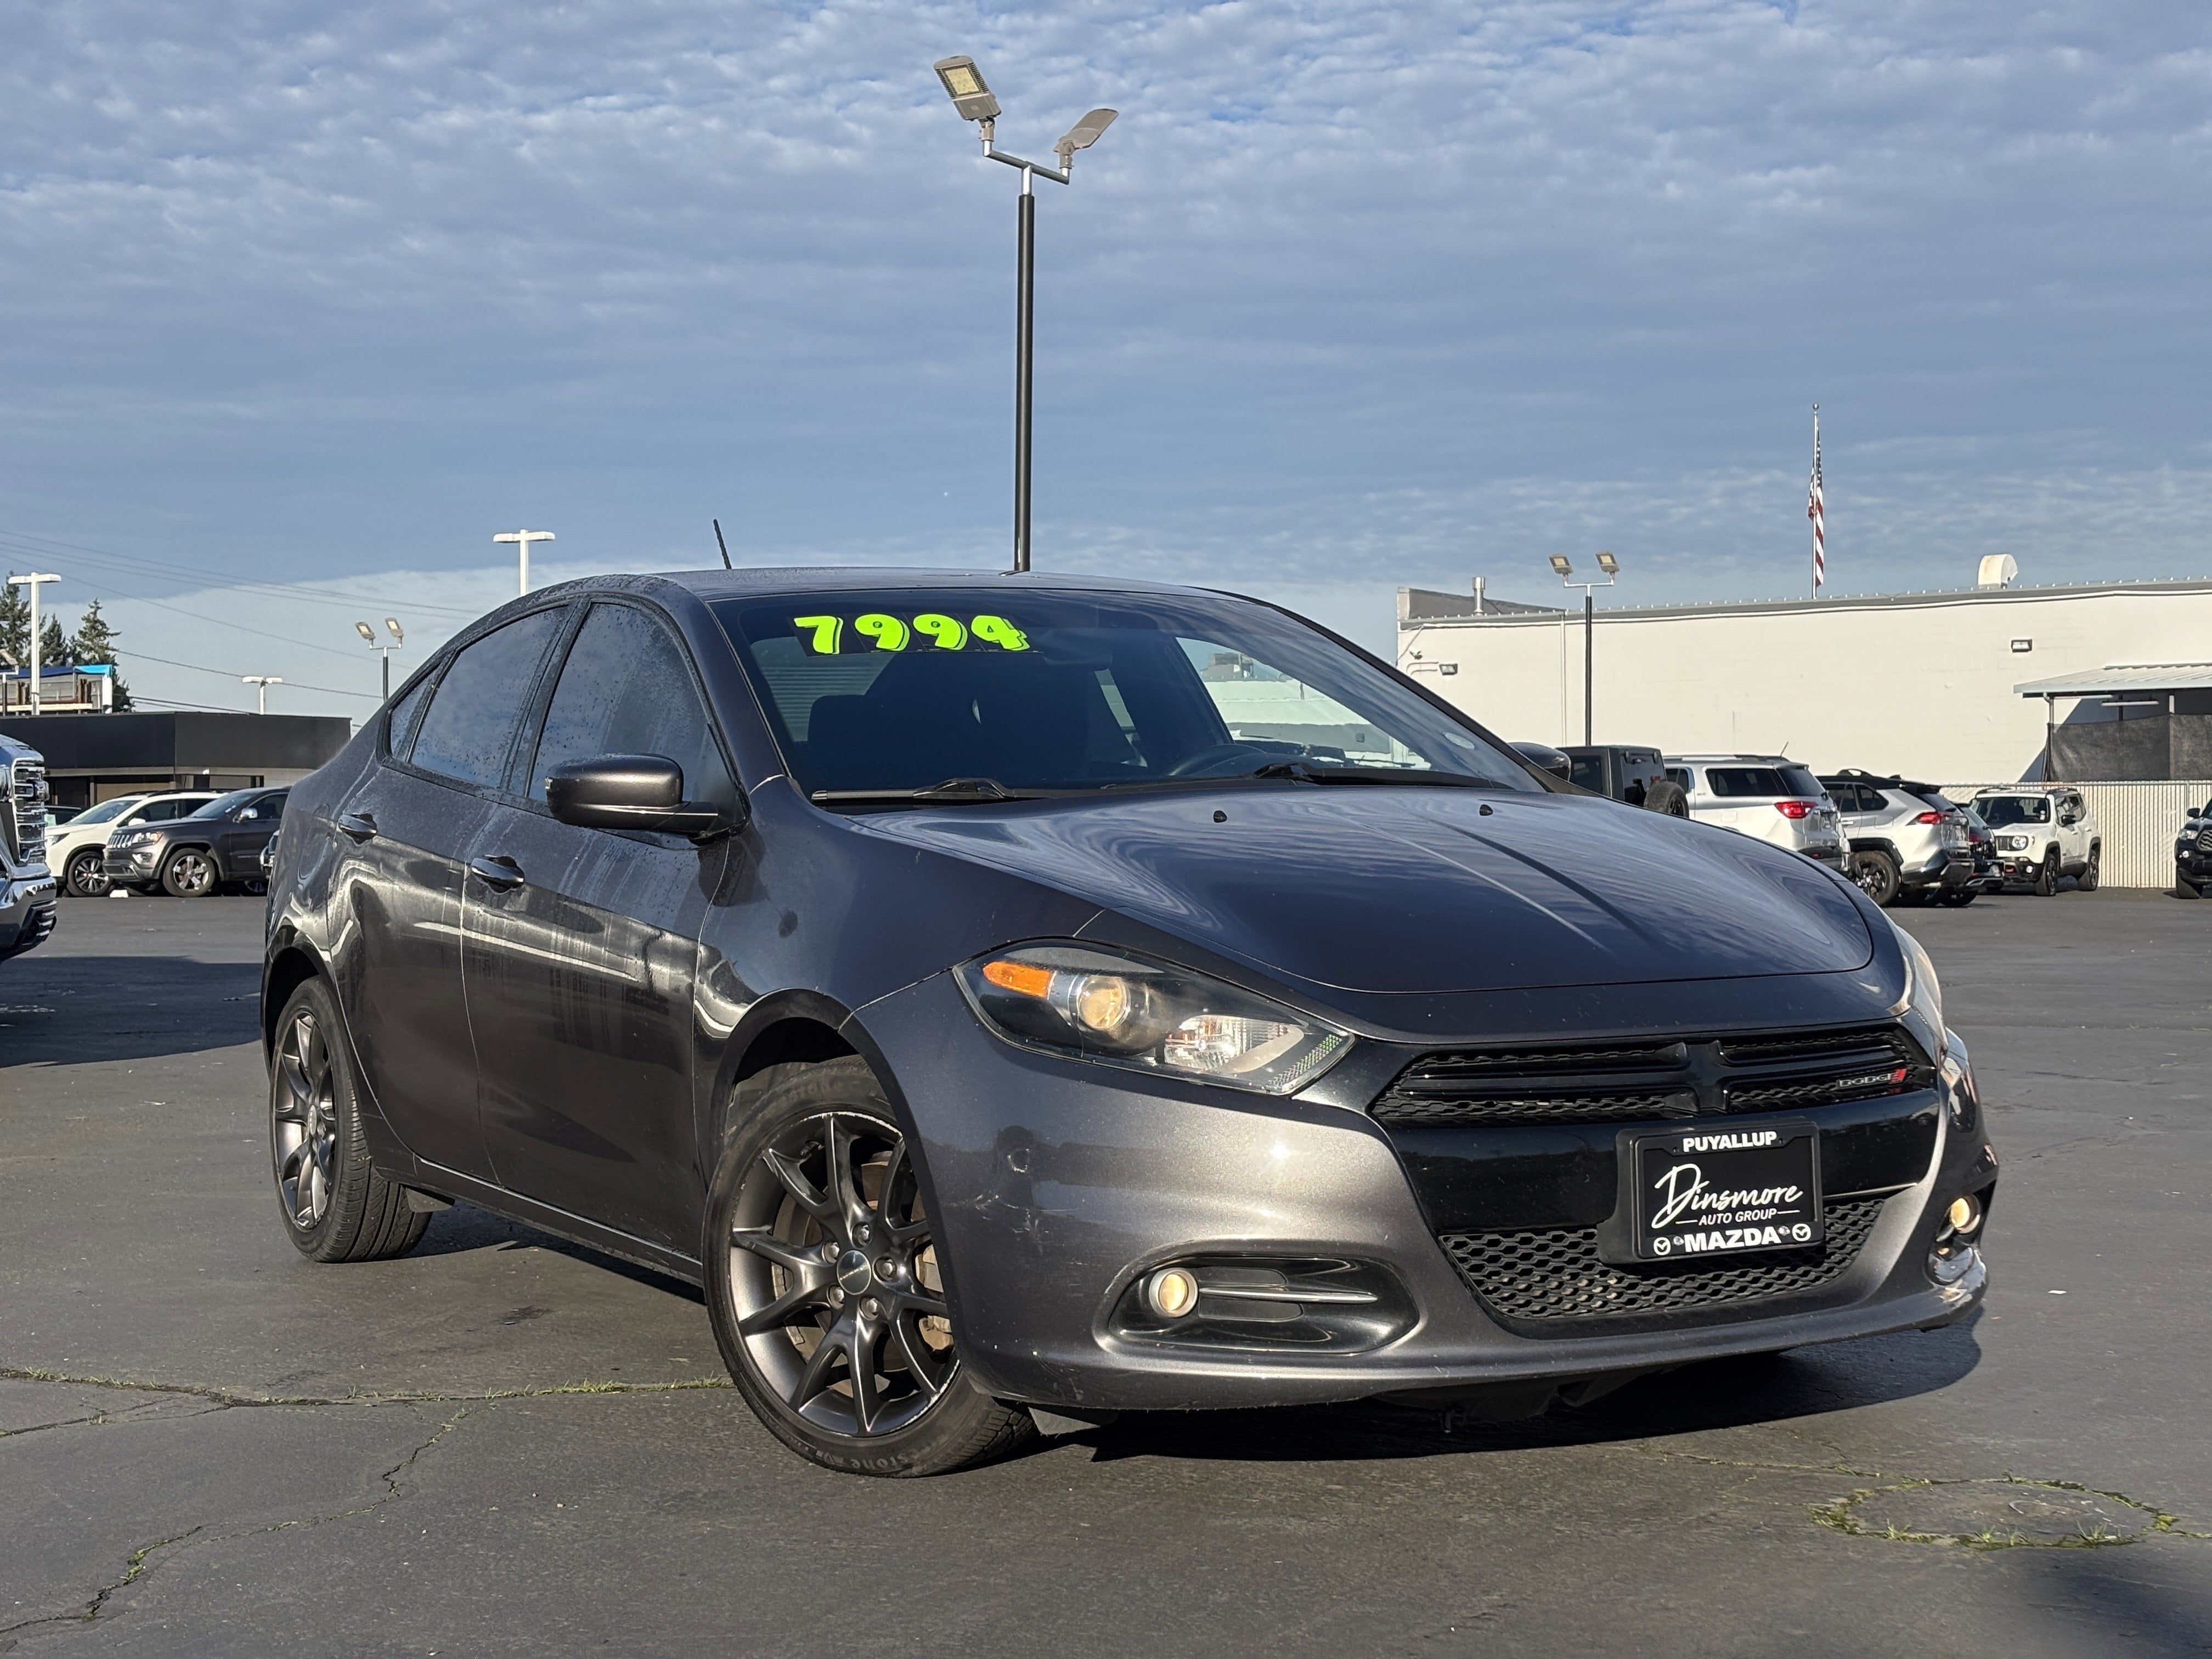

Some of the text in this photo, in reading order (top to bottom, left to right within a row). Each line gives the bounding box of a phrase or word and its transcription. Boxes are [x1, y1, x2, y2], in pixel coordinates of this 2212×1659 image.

[794, 614, 1030, 654] 7994
[1839, 1073, 1895, 1087] DODGE
[1683, 1131, 1777, 1152] PUYALLUP
[1651, 1163, 1803, 1229] Dinsmore
[1699, 1209, 1777, 1226] AUTO GROUP
[1684, 1226, 1782, 1252] MAZDA
